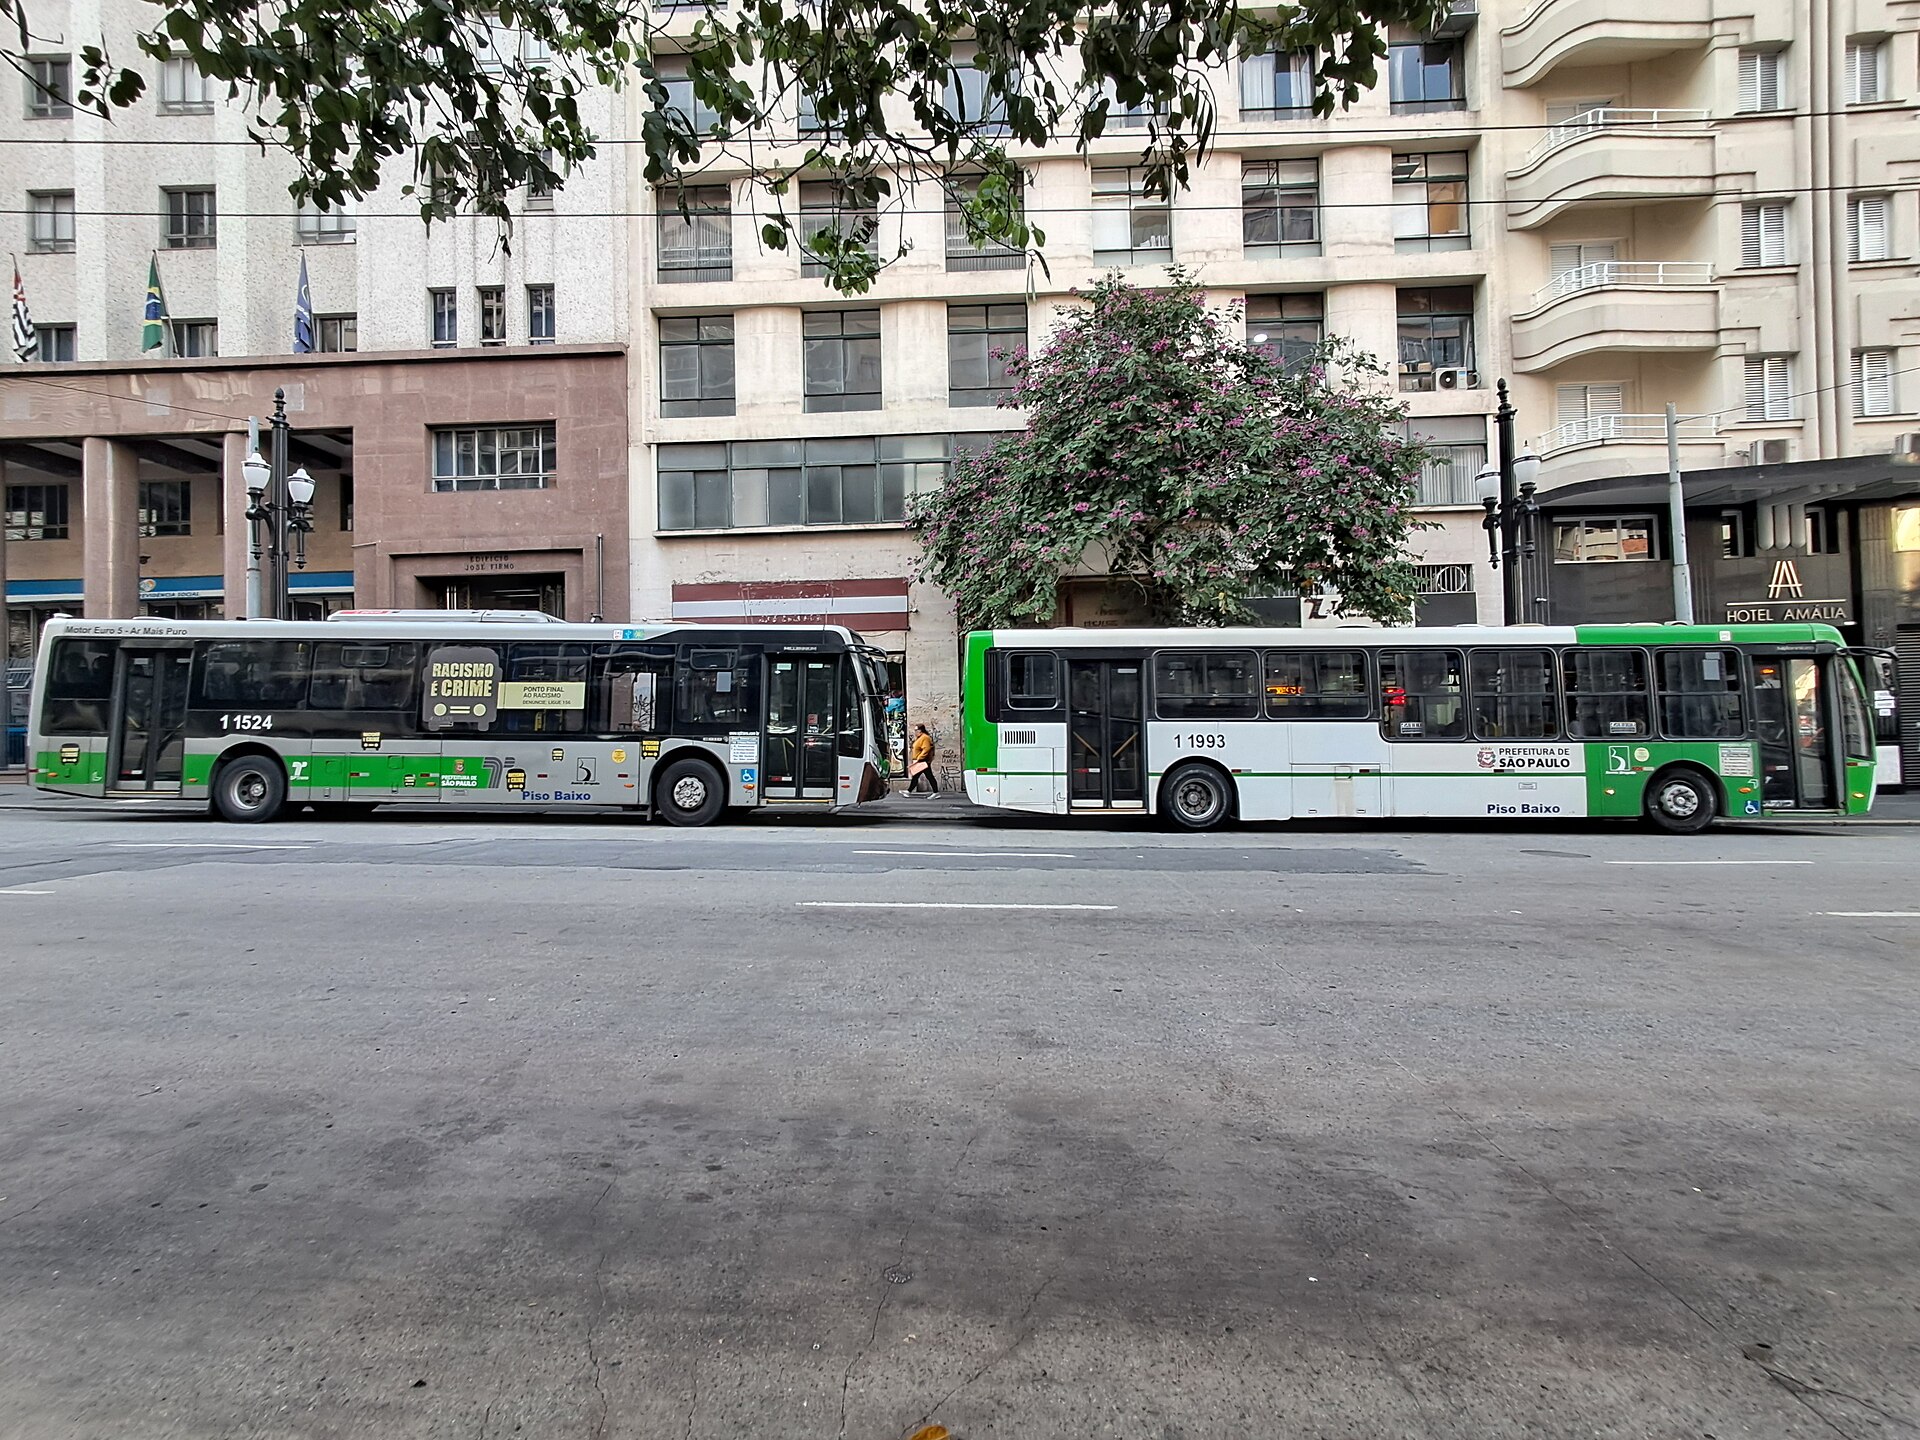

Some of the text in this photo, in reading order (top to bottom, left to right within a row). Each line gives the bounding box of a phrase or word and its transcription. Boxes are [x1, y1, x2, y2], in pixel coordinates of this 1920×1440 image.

[1727, 605, 1847, 622] HOTEL AMÁLIA
[65, 626, 92, 634] Motor
[117, 627, 123, 635] 5
[130, 627, 141, 635] Ar
[432, 663, 494, 678] RACISMO
[431, 679, 493, 697] É CRIME
[220, 714, 273, 730] 1 1524
[1174, 734, 1226, 748] 1 1993
[1499, 748, 1570, 756] PREFEITURA DE
[1499, 756, 1571, 768] SÃO PAULO
[522, 791, 591, 801] Piso Baixo
[1487, 804, 1561, 814] Piso Baixo
